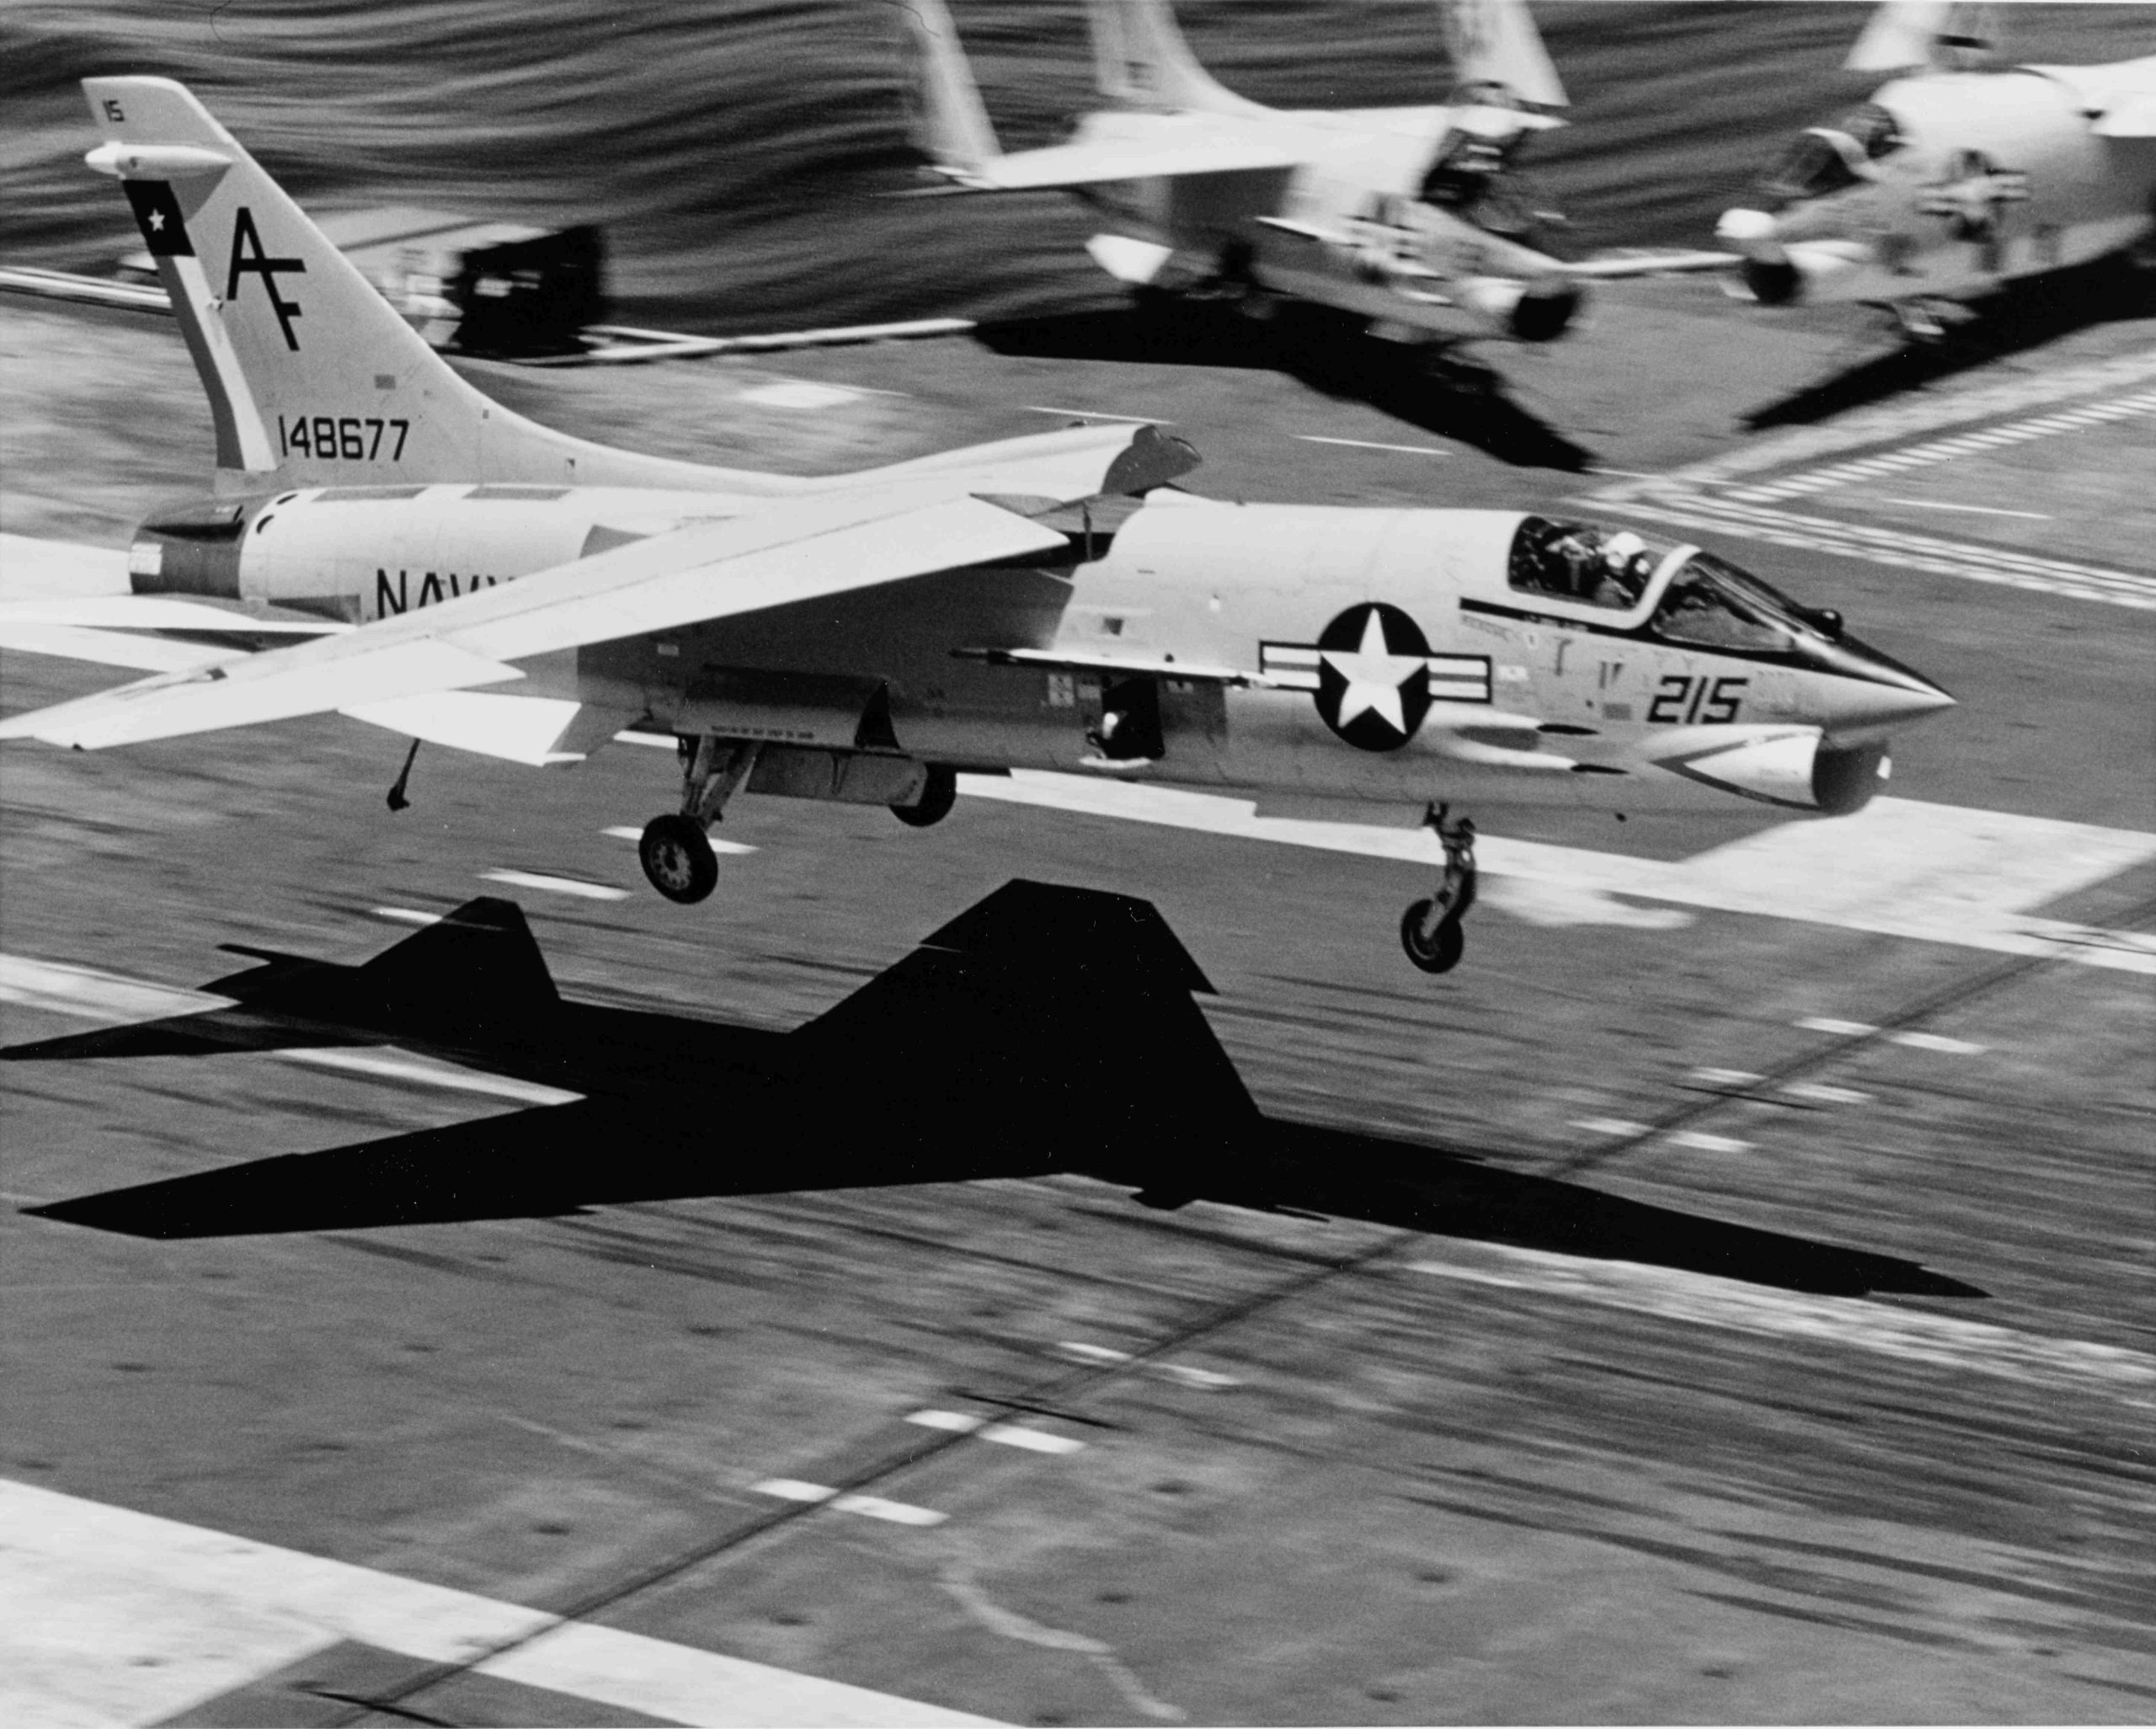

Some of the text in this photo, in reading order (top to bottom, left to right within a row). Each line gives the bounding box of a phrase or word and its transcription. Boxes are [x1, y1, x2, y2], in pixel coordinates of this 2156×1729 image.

[279, 414, 410, 462] 148677
[376, 568, 516, 621] NA
[1646, 675, 1749, 725] 215
